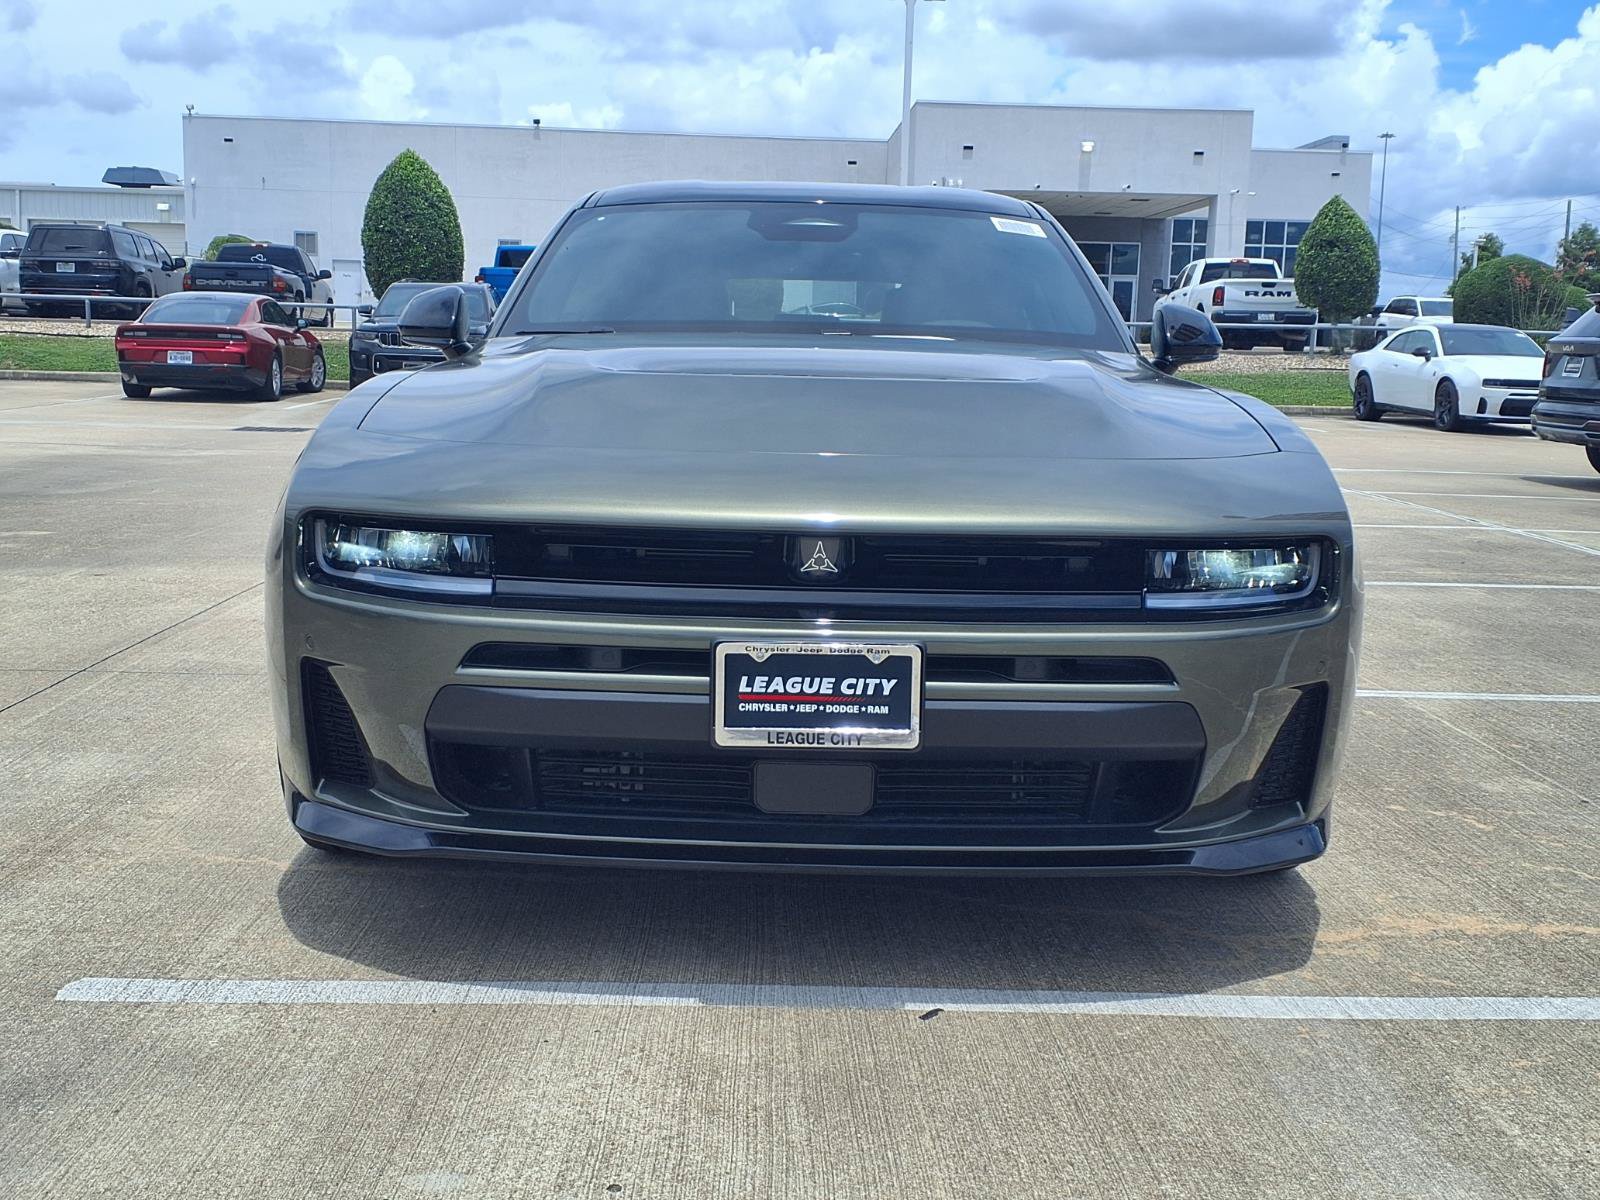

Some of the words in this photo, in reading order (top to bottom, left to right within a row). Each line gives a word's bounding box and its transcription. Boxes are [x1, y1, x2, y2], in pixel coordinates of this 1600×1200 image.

[195, 279, 268, 287] CHEVROLET
[745, 645, 790, 654] Chrysler
[866, 647, 891, 655] Ram
[738, 675, 836, 694] LEAGUE
[840, 677, 898, 695] CITY
[738, 702, 788, 712] CHRYSLER
[795, 703, 818, 713] JEEP
[825, 704, 860, 713] DODGE
[867, 705, 889, 714] RAM
[767, 731, 825, 745] LEAGUE
[830, 732, 863, 746] CITY
